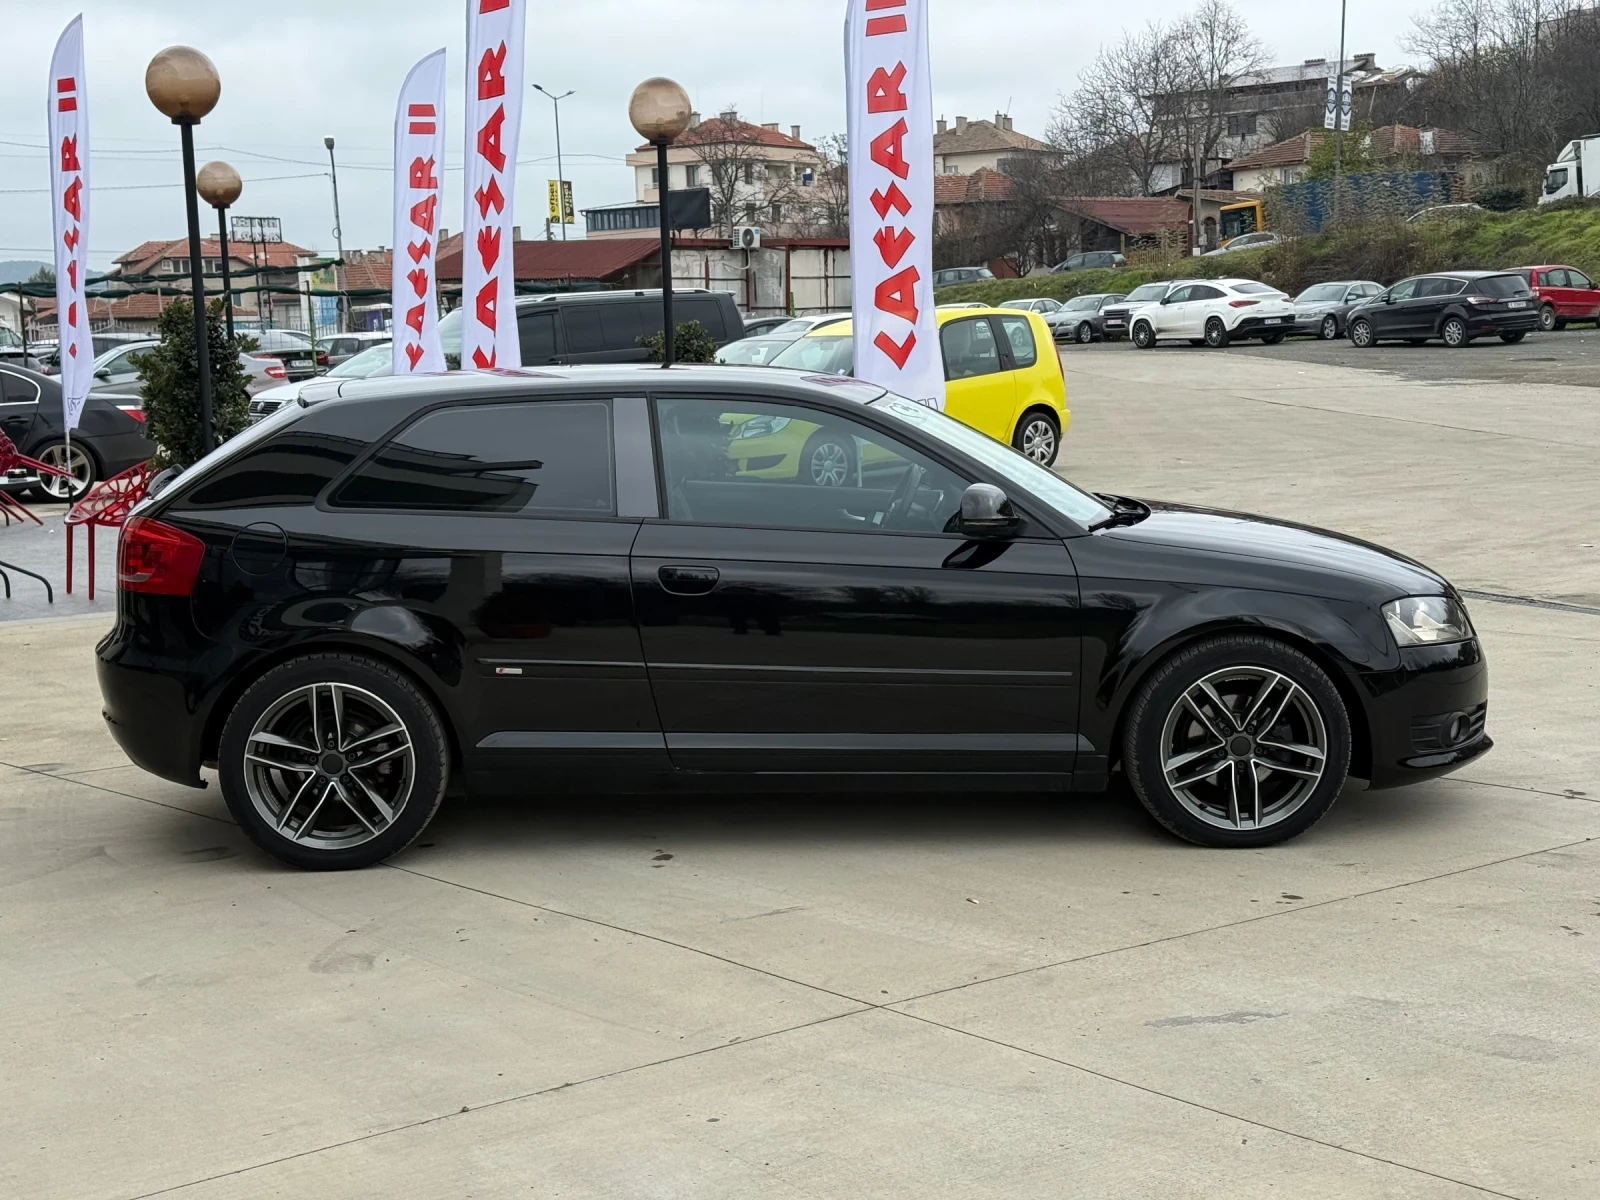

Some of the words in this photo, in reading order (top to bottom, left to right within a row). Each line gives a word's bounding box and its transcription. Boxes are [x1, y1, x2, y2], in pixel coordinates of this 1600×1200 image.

[57, 77, 77, 112] II
[408, 103, 436, 135] II
[404, 153, 438, 372] CAESAR
[867, 59, 921, 371] CAESAR
